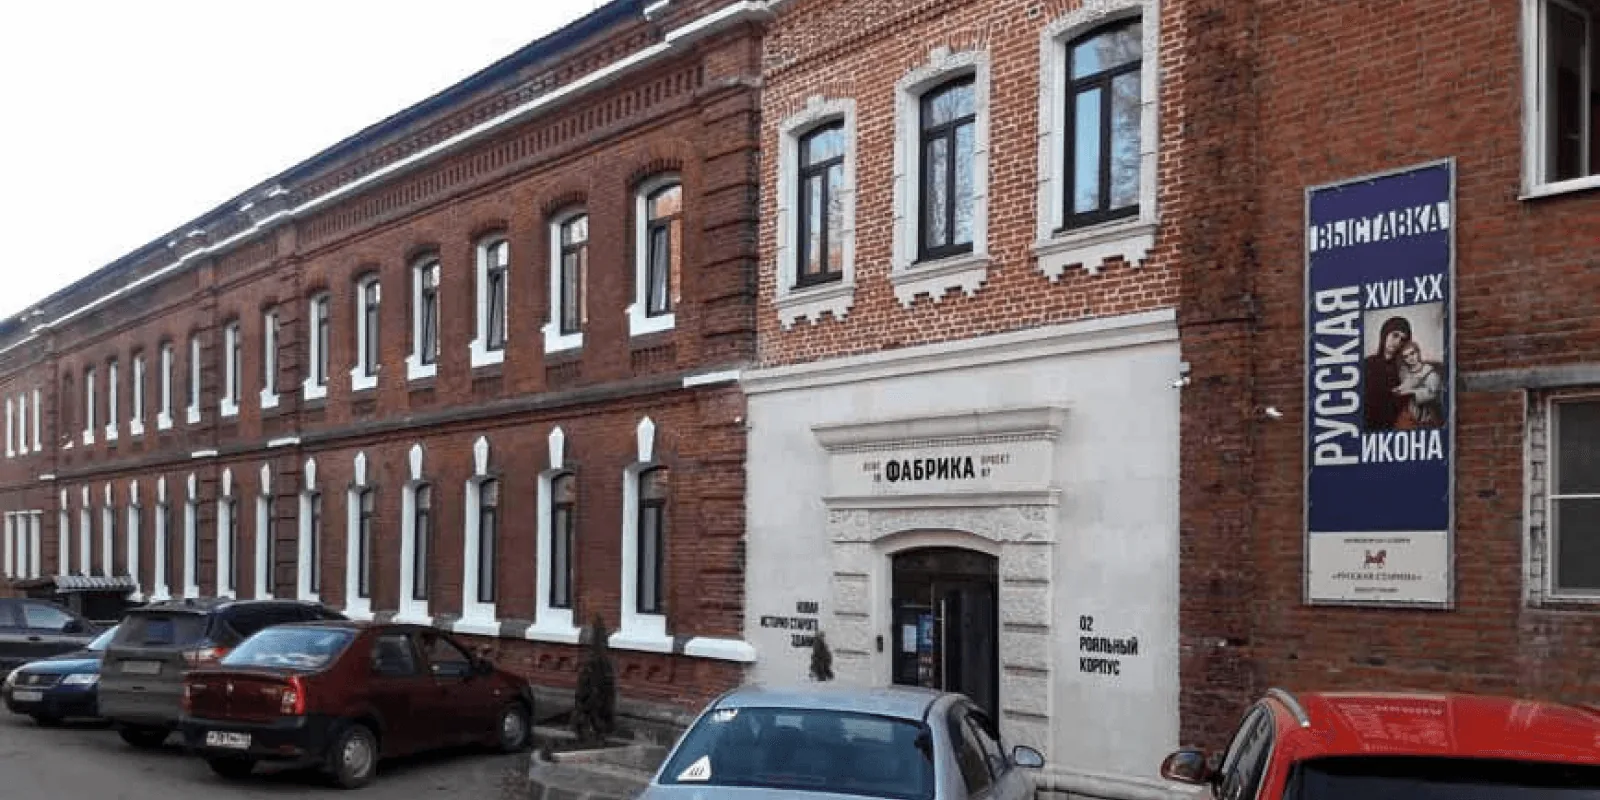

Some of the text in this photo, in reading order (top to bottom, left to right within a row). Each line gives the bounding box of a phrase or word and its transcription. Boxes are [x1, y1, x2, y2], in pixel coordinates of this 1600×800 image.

[1311, 202, 1448, 251] ВЫСТАВКА
[1365, 274, 1443, 309] XVII-XX
[1315, 285, 1360, 466] РУССКАЯ
[1361, 429, 1444, 463] ИКОНА
[886, 455, 976, 483] ФАБРИКА
[1079, 614, 1094, 632] 02
[1079, 636, 1139, 656] РОЯЛЬНЫЙ
[1079, 657, 1120, 676] КОРПУС
